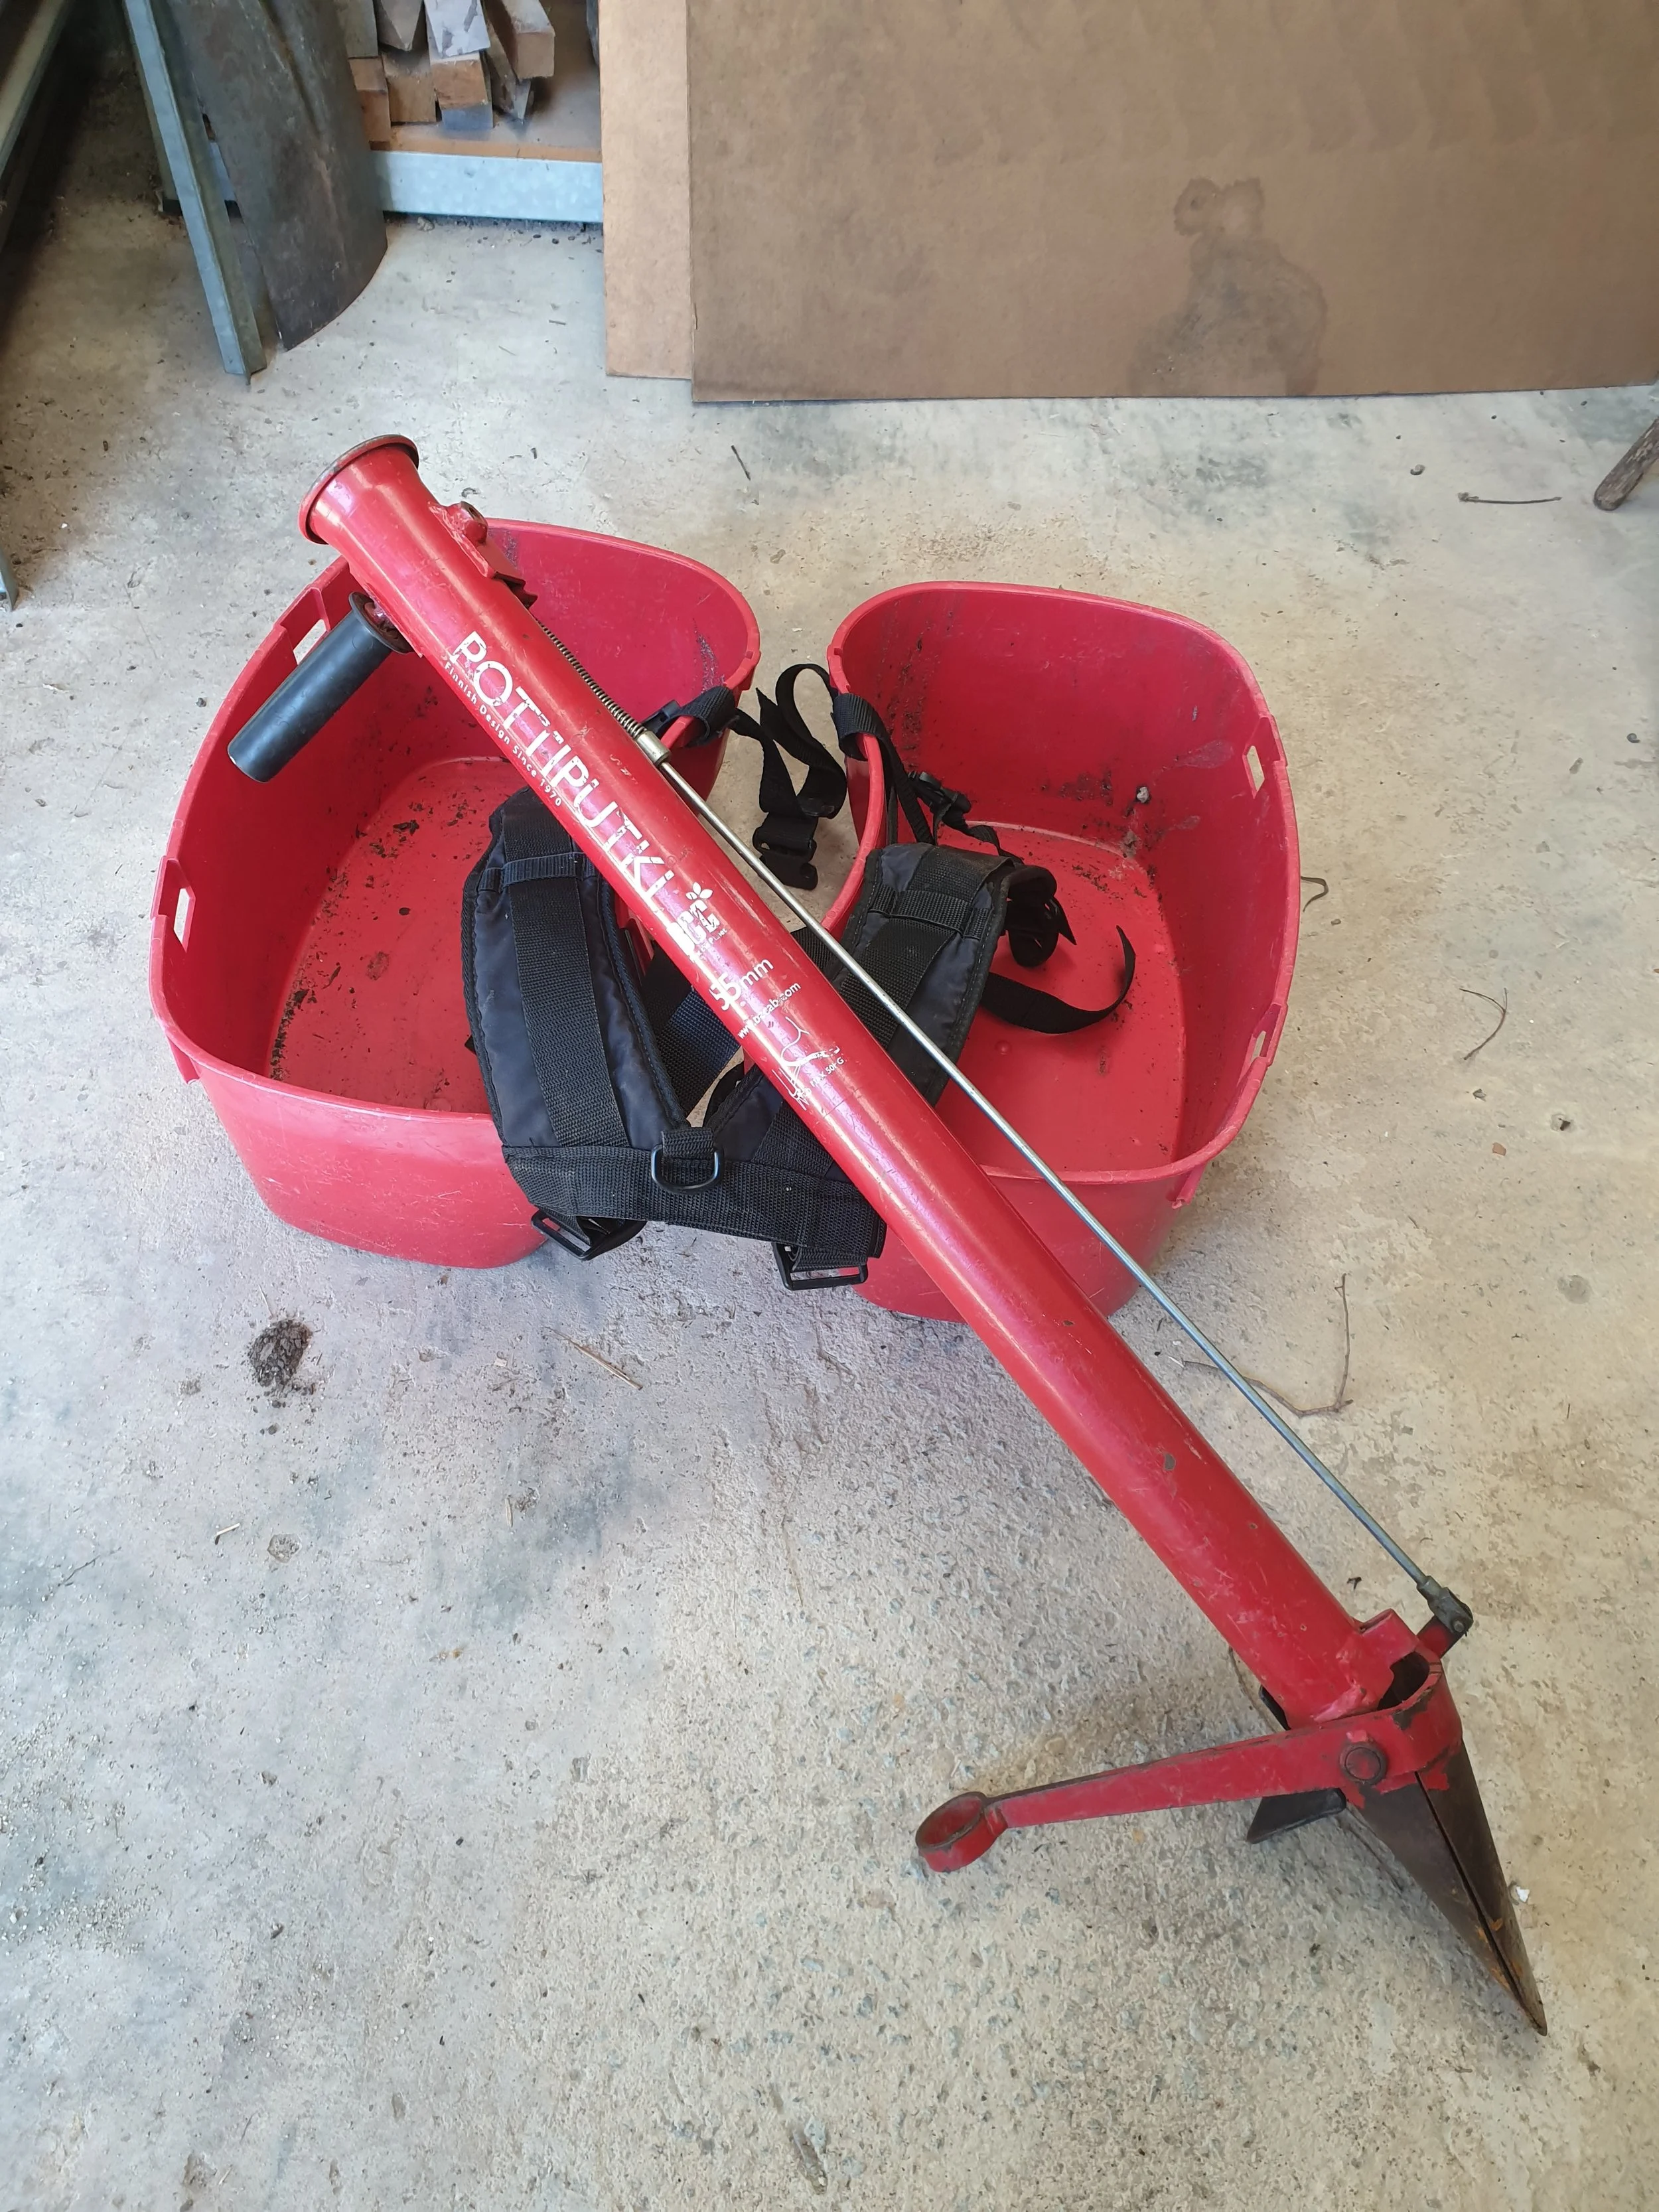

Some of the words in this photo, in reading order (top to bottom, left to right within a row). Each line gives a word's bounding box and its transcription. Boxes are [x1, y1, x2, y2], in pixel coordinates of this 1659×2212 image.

[445, 662, 477, 705] Finnish
[479, 704, 510, 745] Design
[512, 745, 537, 777] Since
[540, 778, 562, 806] 1970
[449, 630, 675, 899] POTTIPUTKI
